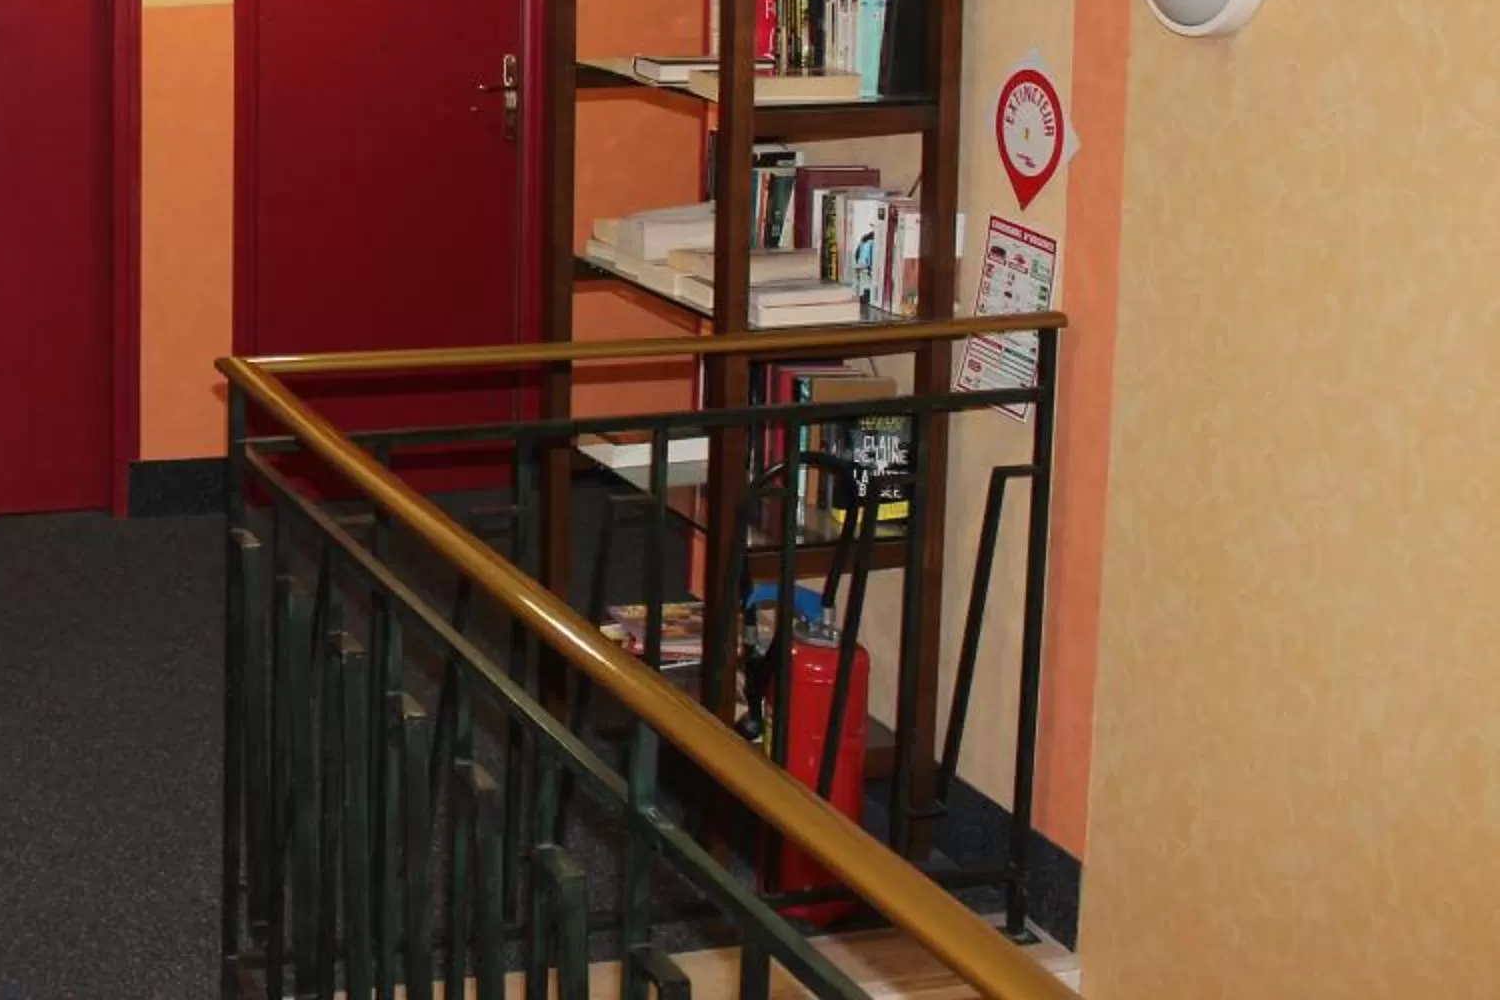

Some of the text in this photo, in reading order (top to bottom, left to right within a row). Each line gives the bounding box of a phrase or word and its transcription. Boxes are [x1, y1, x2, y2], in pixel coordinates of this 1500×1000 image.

[1006, 84, 1055, 137] EXTINCTEUR
[863, 435, 901, 450] CLAIR
[875, 448, 909, 465] LUNE
